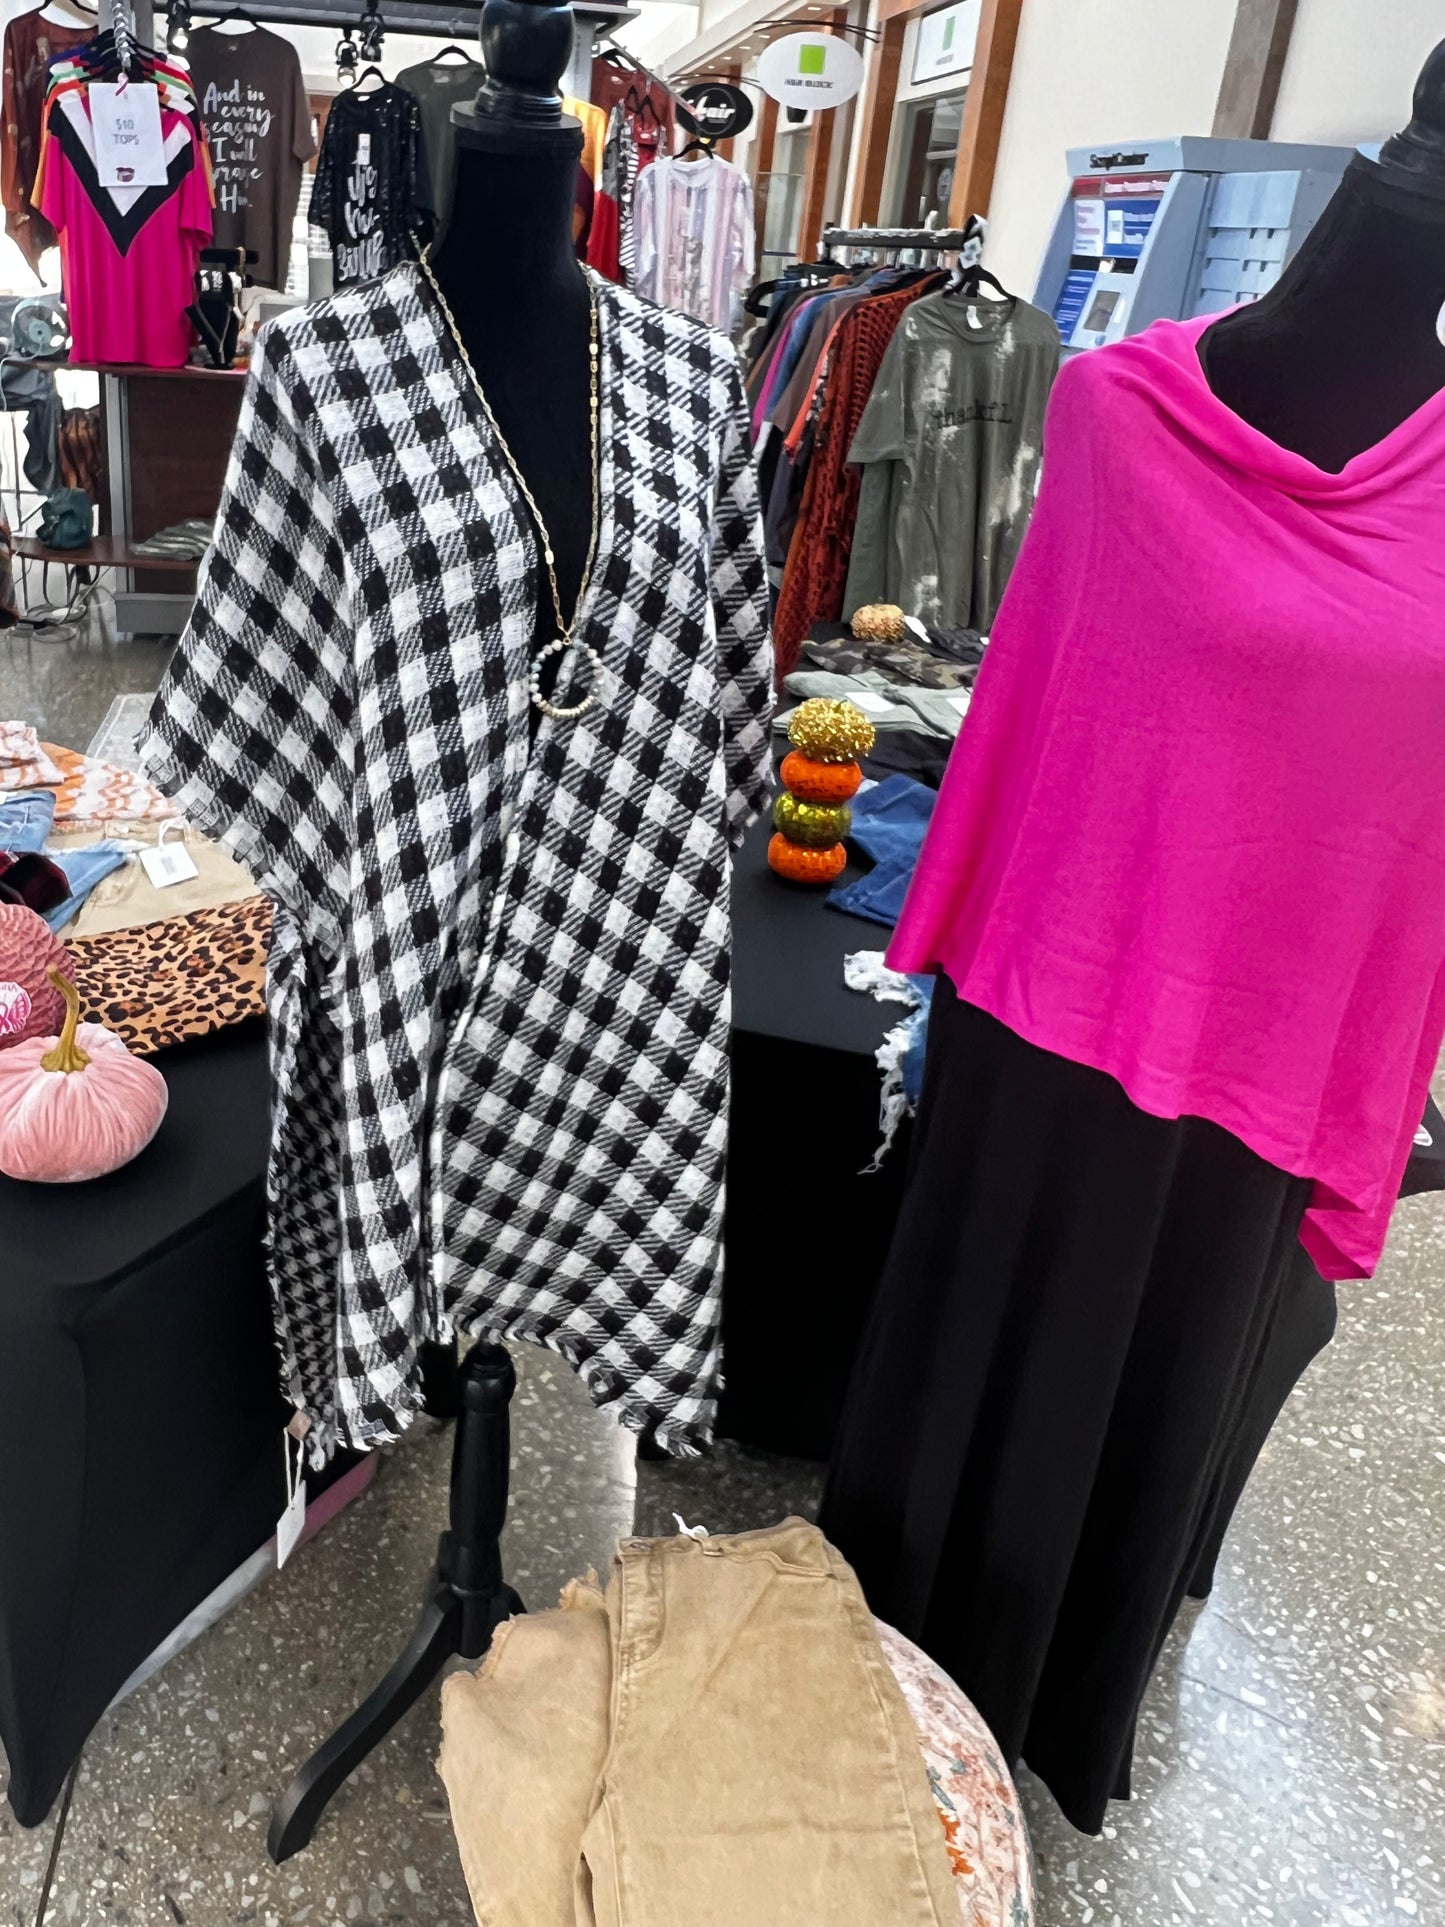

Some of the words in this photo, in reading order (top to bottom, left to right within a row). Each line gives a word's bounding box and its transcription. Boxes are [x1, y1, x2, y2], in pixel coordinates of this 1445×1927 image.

[203, 79, 240, 115] And
[247, 84, 266, 101] in
[115, 118, 134, 131] $10
[221, 105, 275, 137] every
[112, 133, 140, 146] TOPS
[211, 137, 229, 162] I
